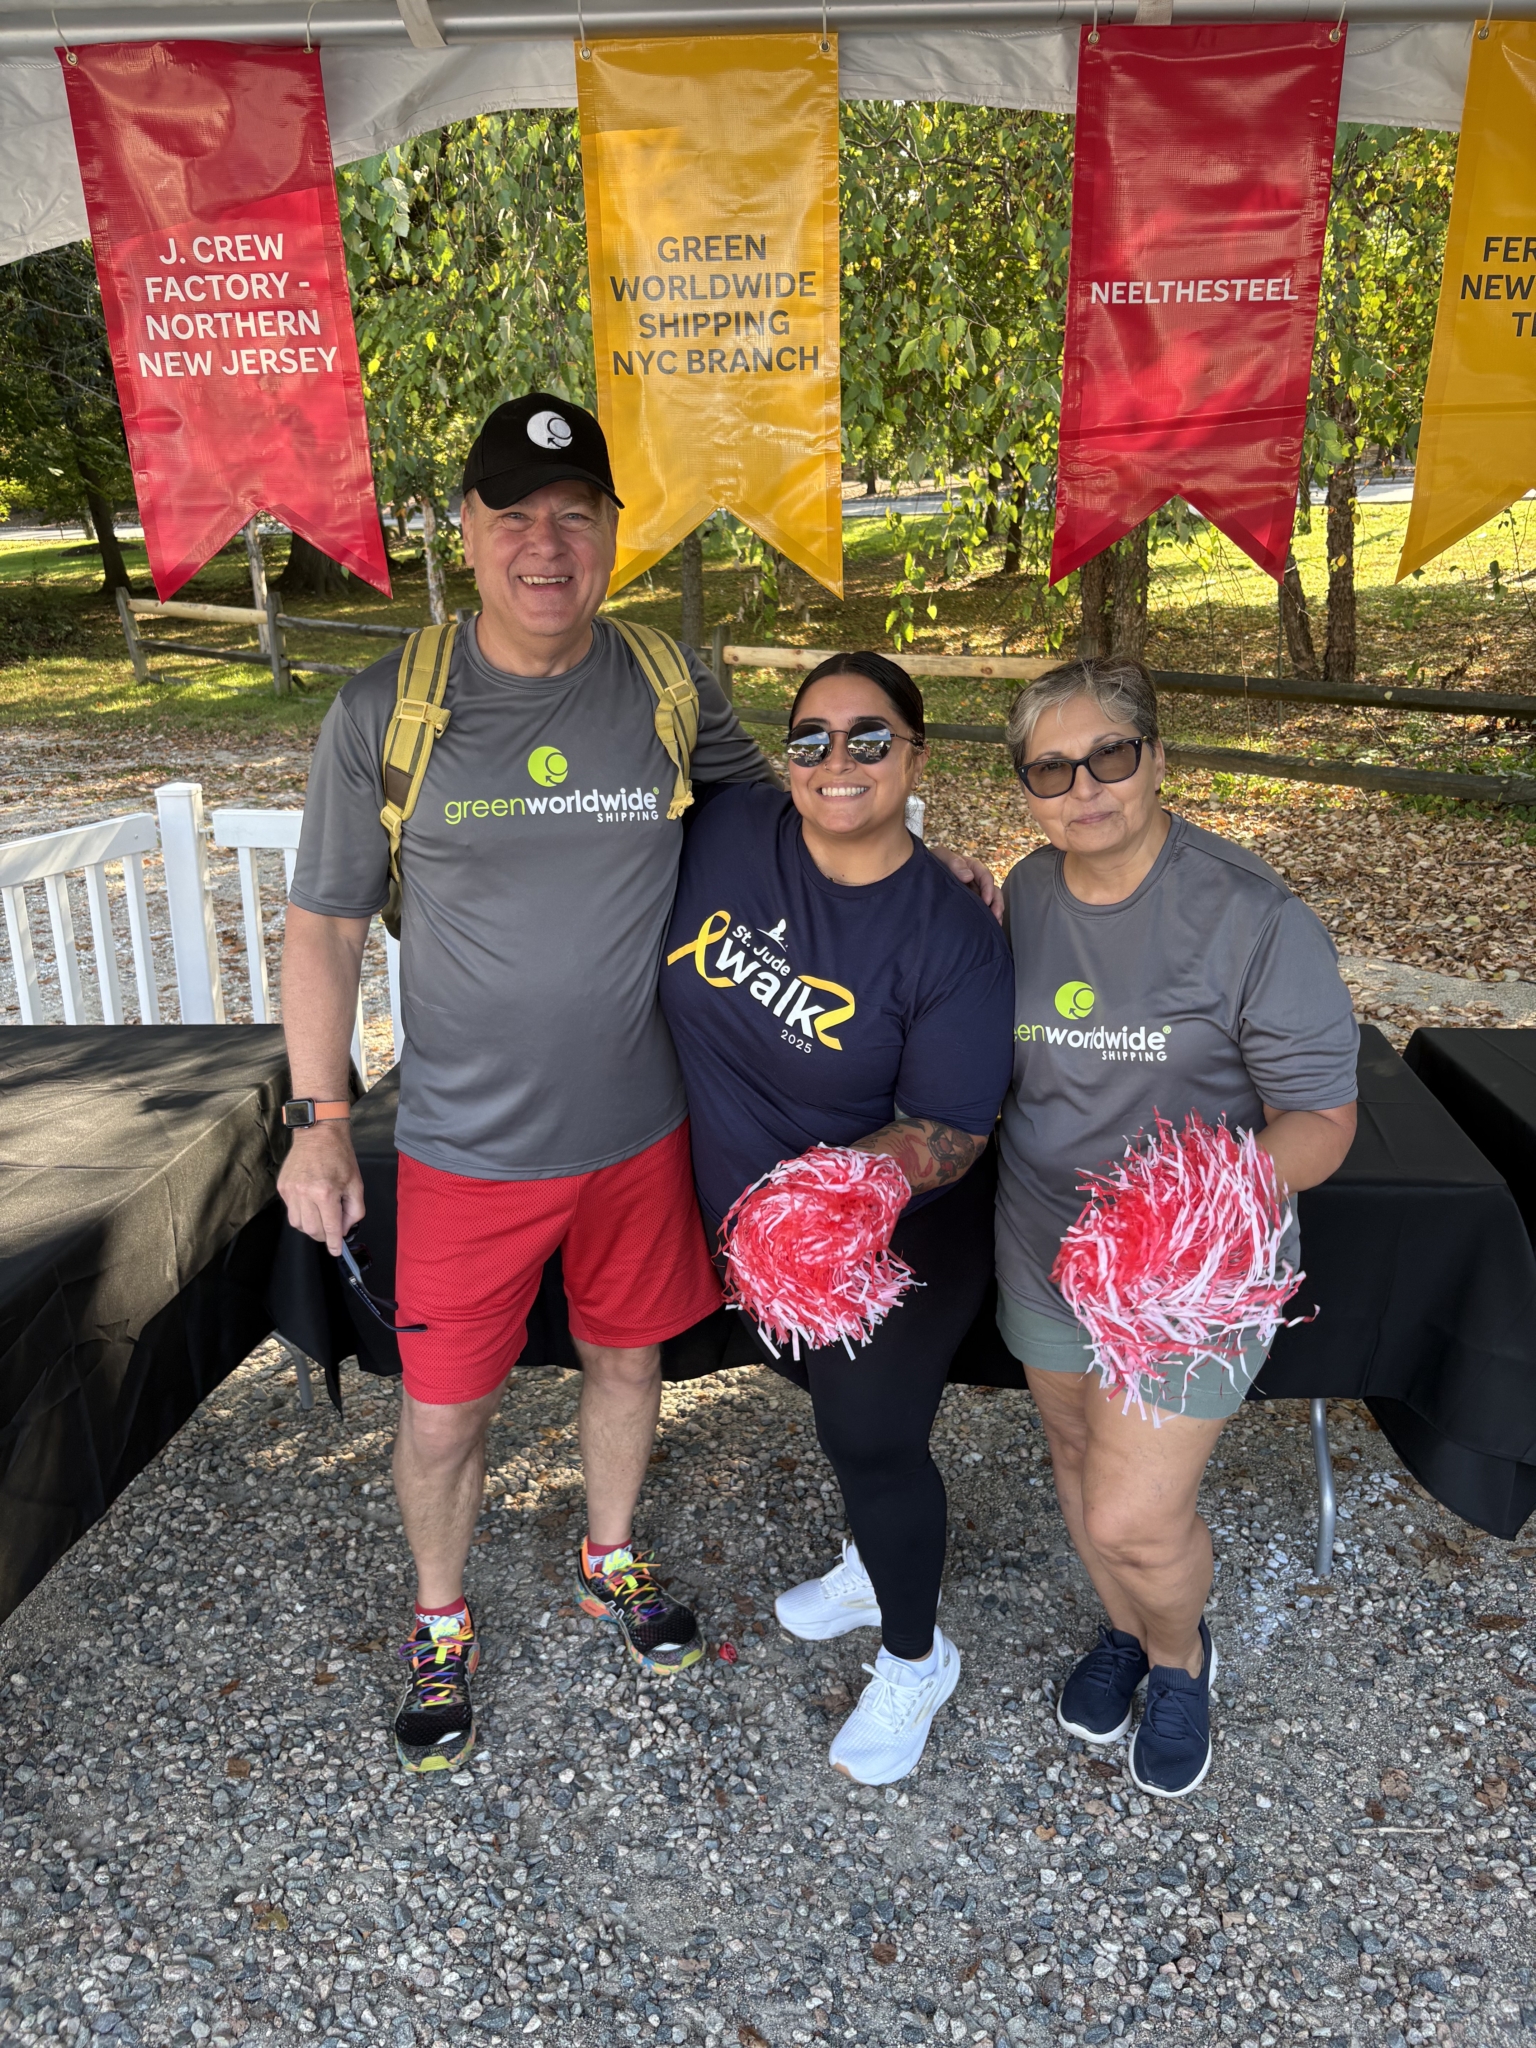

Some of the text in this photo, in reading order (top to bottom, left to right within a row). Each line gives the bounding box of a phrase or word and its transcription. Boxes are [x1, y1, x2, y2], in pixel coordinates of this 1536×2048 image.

[159, 233, 284, 265] J. CREW
[657, 233, 767, 263] GREEN
[145, 272, 290, 303] FACTORY
[609, 270, 817, 302] WORLDWIDE
[1090, 278, 1299, 304] NEELTHESTEEL
[1460, 274, 1536, 300] NEW
[145, 309, 321, 341] NORTHERN
[638, 309, 790, 339] SHIPPING
[138, 346, 338, 378] NEW JERSEY
[612, 345, 819, 376] NYC BRANCH
[596, 810, 660, 823] SHIPPING
[731, 924, 791, 976] St. Jude
[715, 937, 826, 1039] walk
[780, 1029, 812, 1054] 2025
[1013, 1023, 1167, 1051] enworldwide
[1101, 1050, 1168, 1062] SHIPPING
